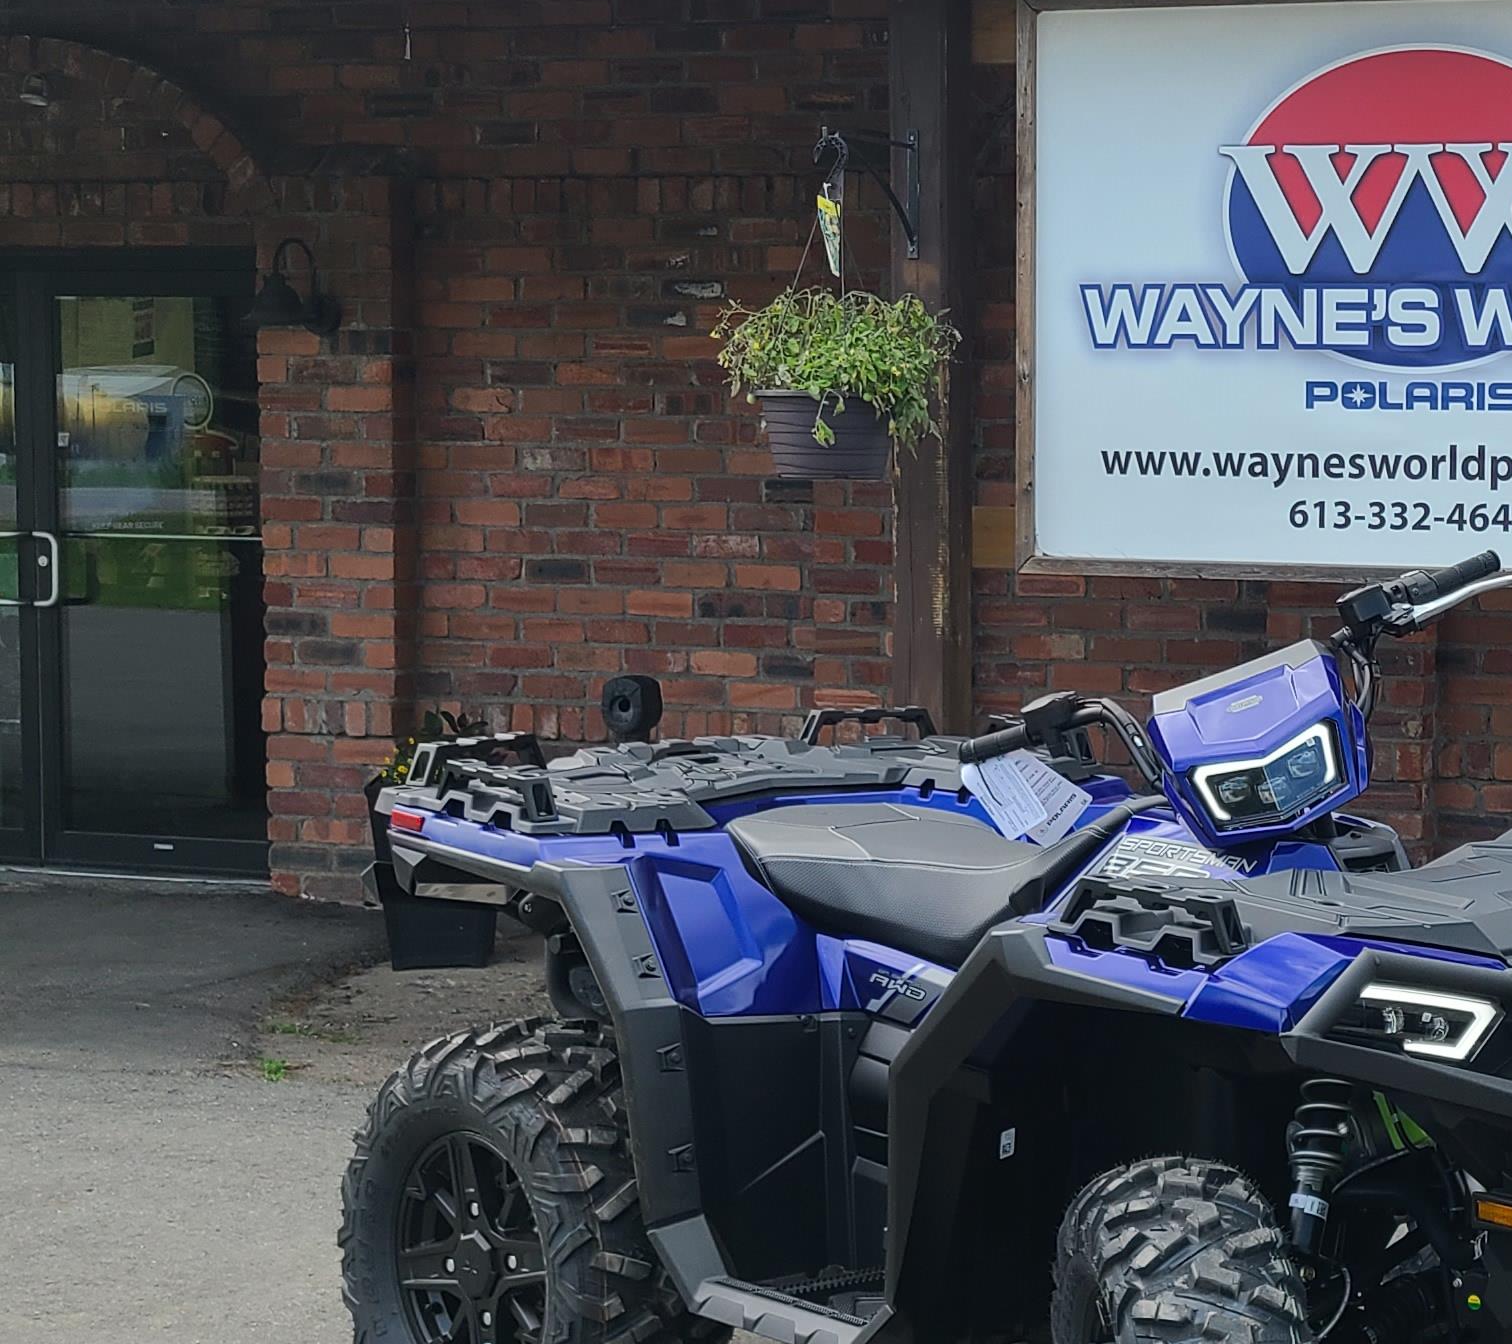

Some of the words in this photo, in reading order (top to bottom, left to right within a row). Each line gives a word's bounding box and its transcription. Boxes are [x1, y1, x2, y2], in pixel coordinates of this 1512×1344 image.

[1079, 283, 1443, 350] WAYNE'S
[1117, 836, 1259, 874] SPORTSMAN
[868, 971, 928, 1002] AWD
